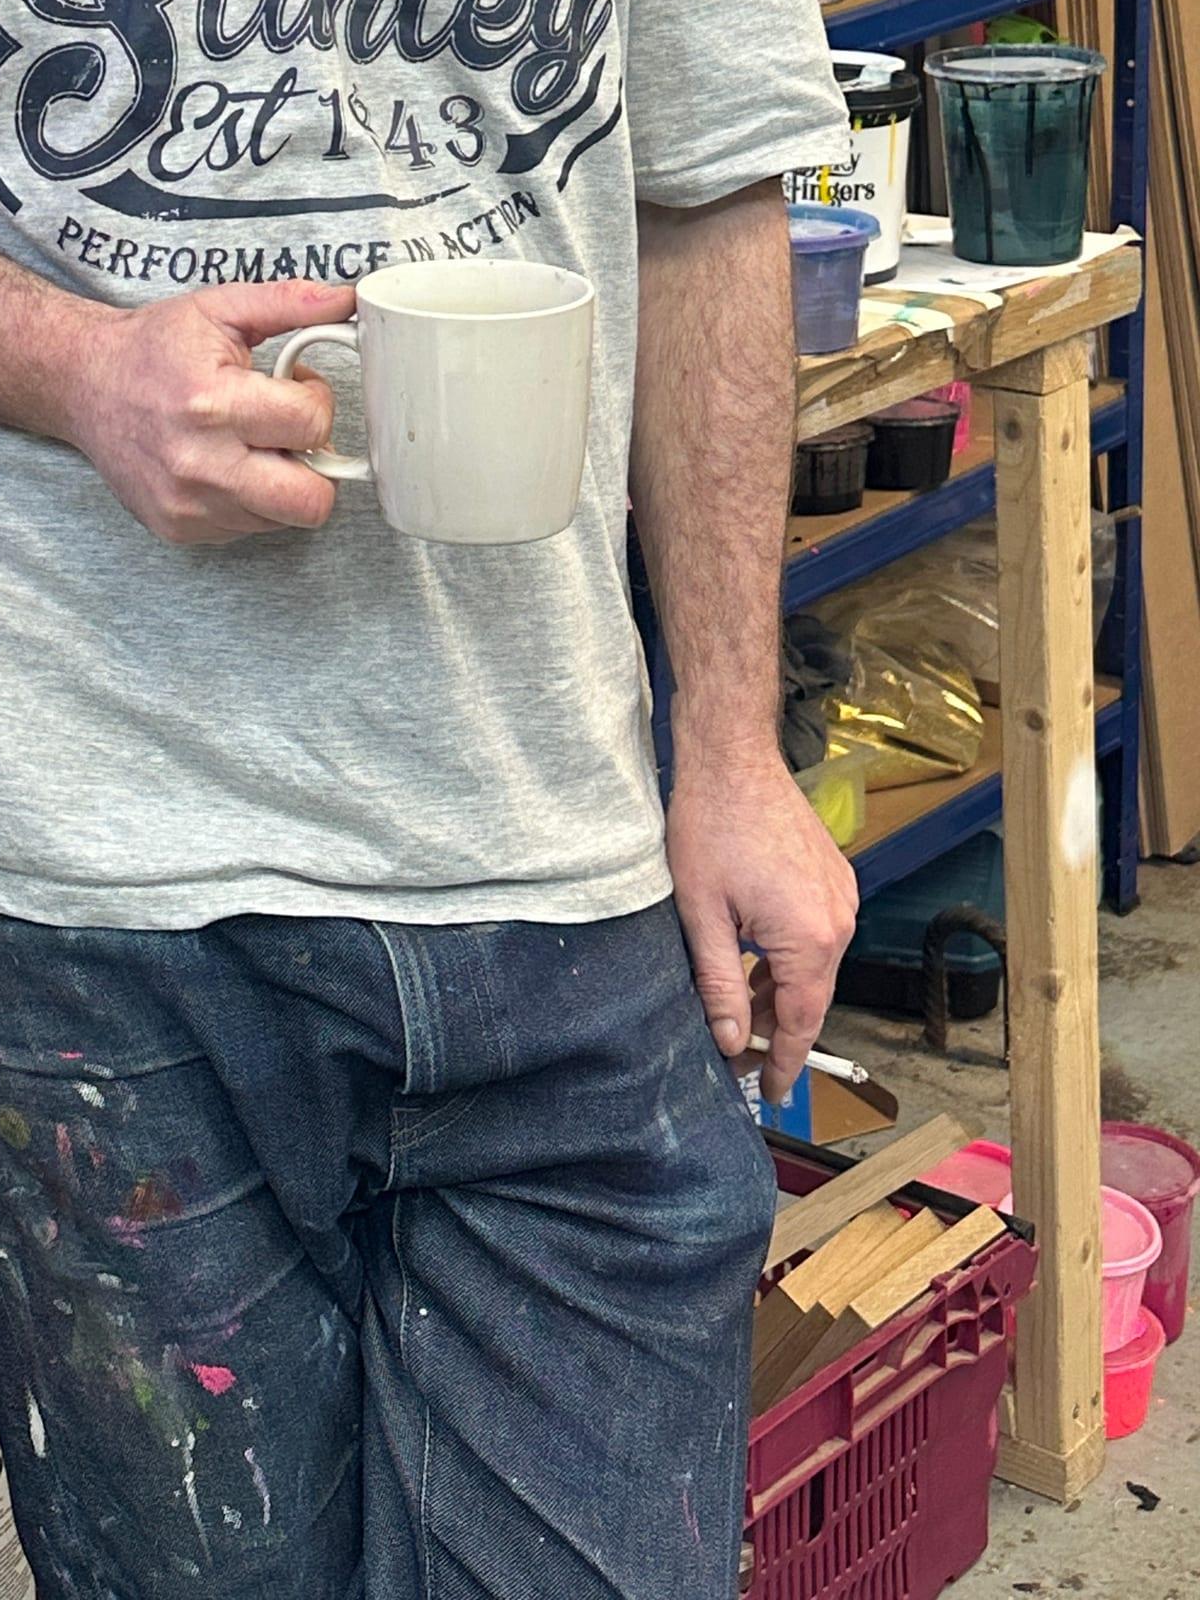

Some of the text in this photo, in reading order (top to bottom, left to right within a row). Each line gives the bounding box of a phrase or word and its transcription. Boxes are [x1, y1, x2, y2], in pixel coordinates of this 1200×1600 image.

[148, 67, 318, 182] Est
[58, 215, 391, 284] PERFORMANCE
[401, 237, 435, 262] IN
